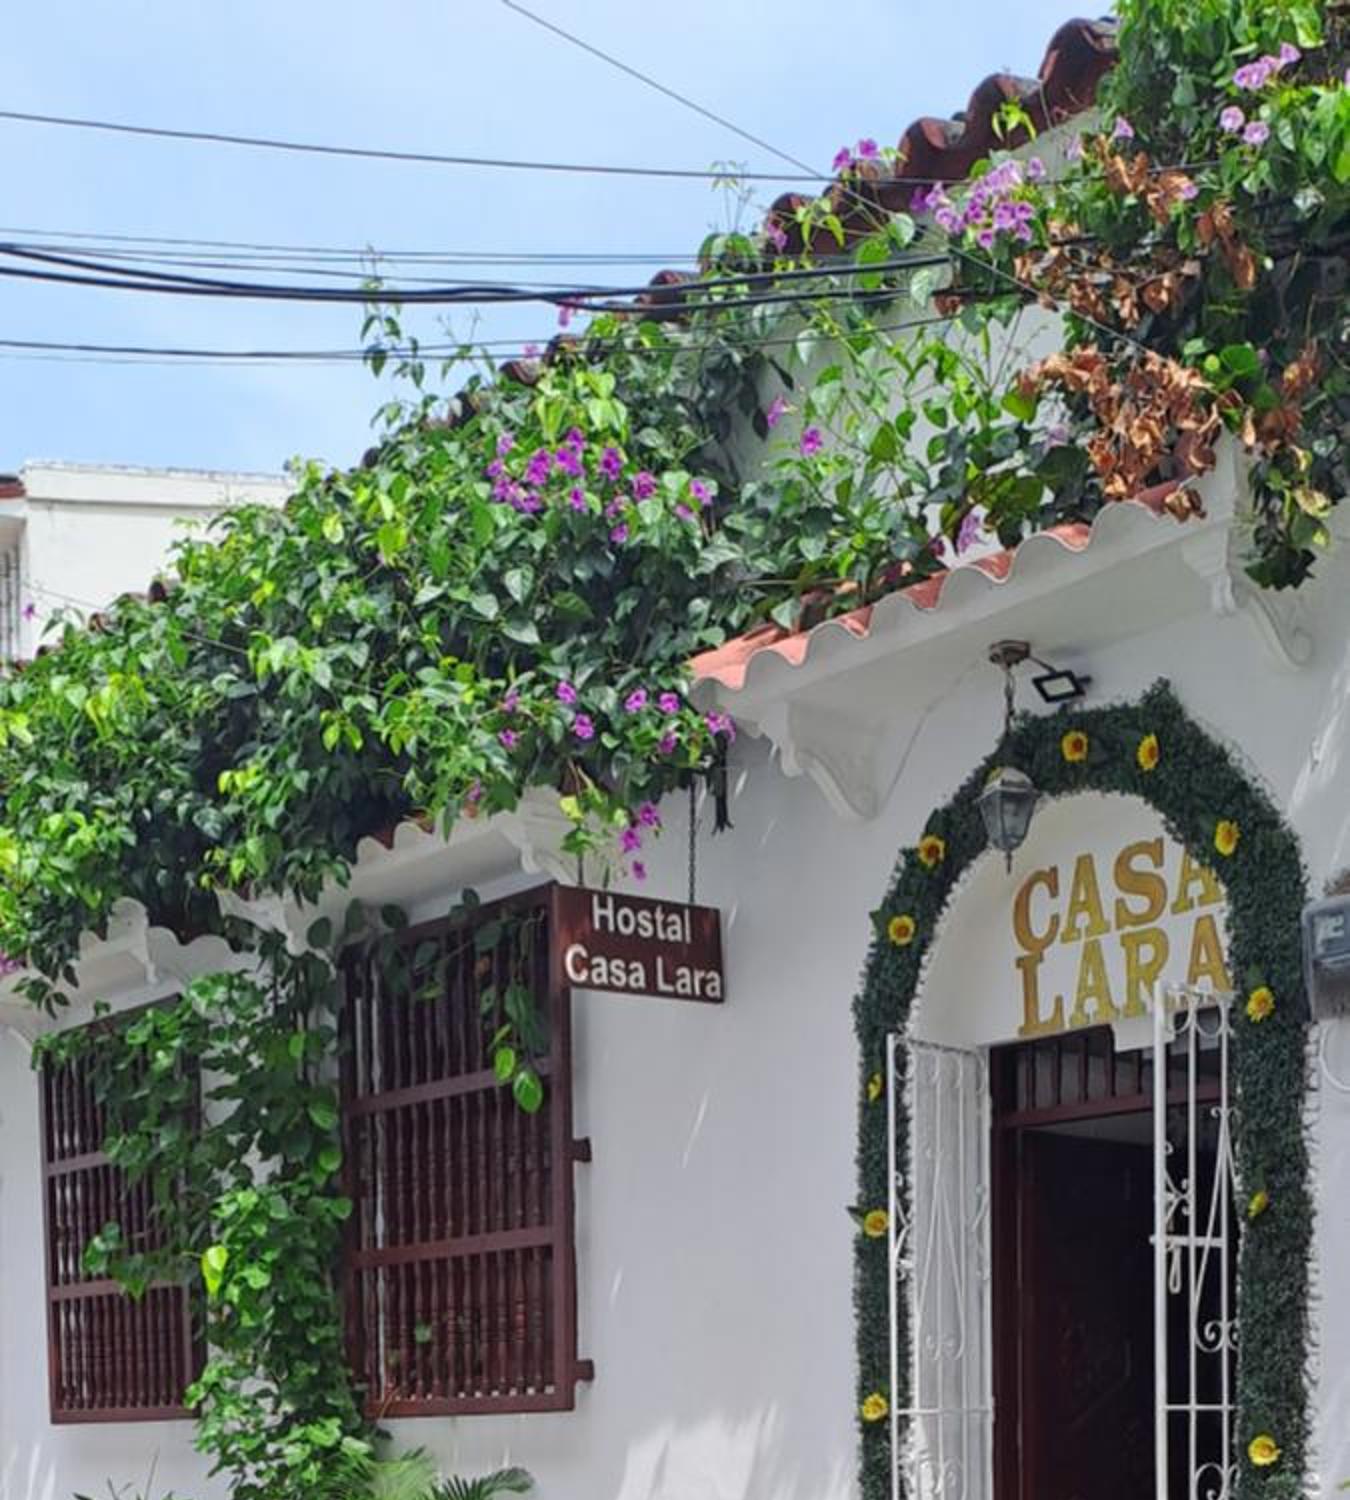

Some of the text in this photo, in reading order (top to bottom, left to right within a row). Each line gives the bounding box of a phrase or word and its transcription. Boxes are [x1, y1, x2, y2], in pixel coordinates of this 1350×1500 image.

[592, 894, 691, 944] Hostal
[1013, 838, 1226, 953] CASA
[565, 943, 721, 998] Casa Lara
[1015, 914, 1234, 1037] LARA
